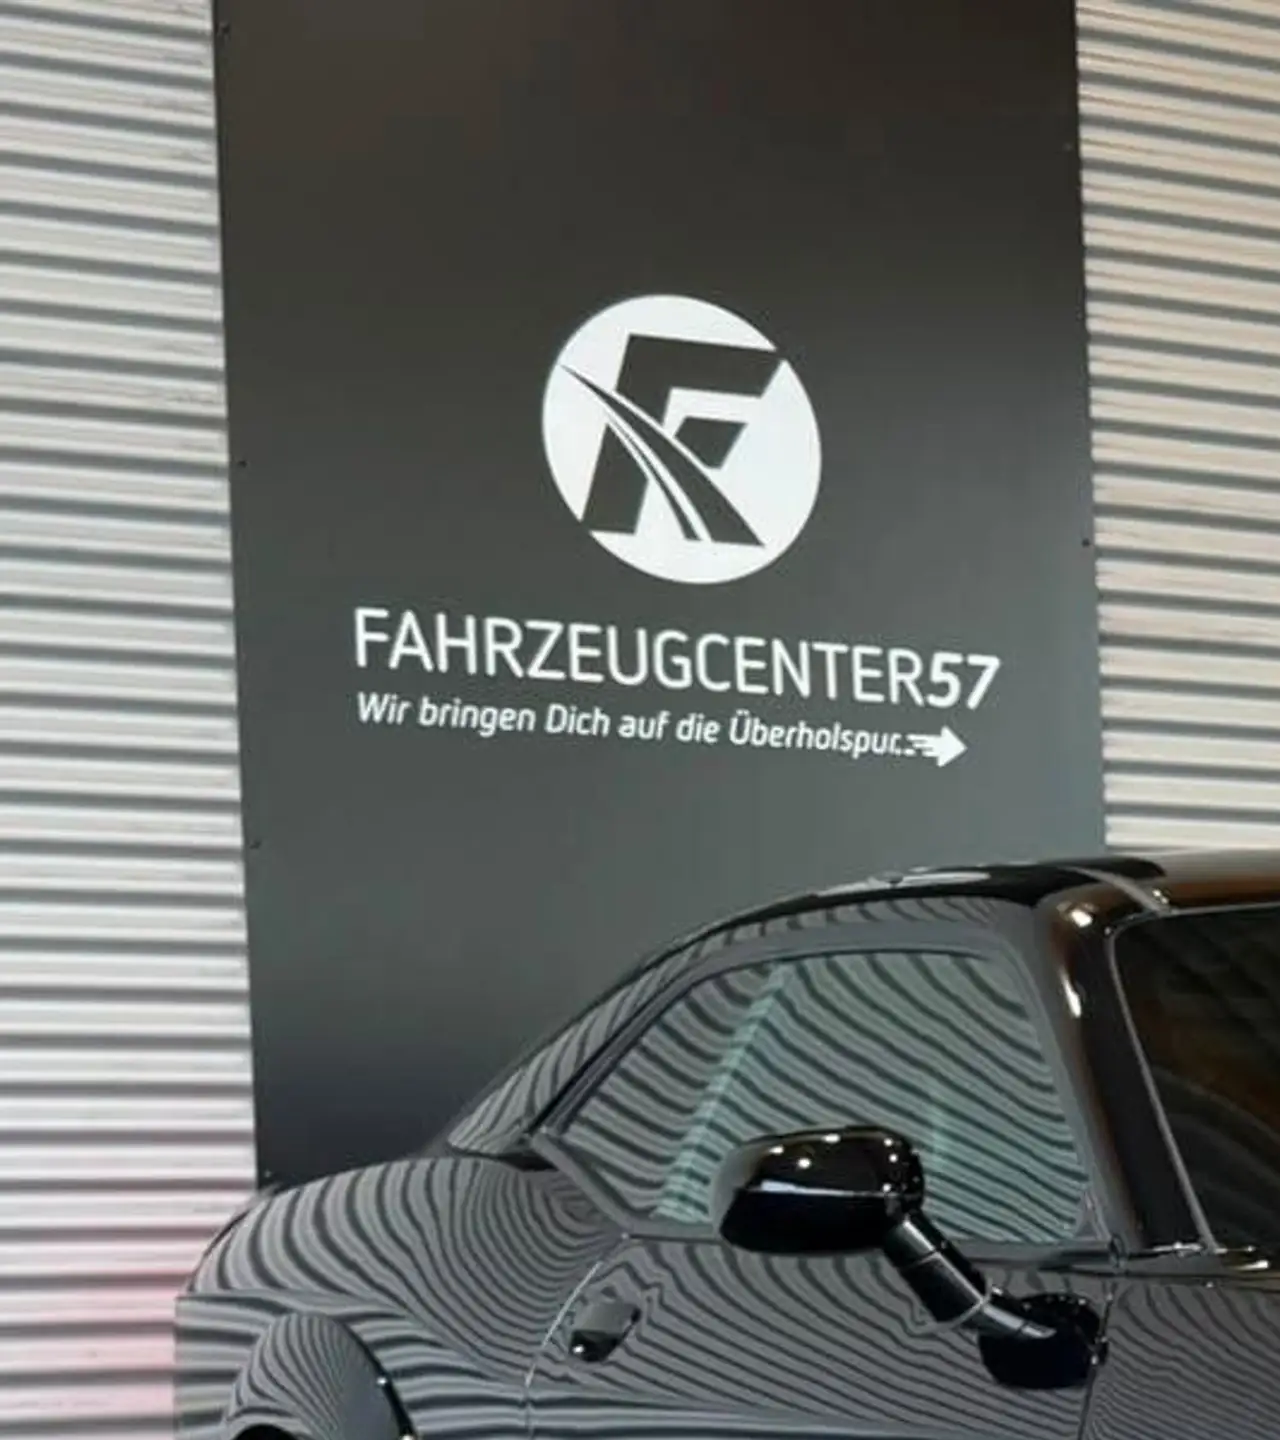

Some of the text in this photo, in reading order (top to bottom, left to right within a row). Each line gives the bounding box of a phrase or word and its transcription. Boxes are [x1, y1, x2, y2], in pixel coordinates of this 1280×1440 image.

[354, 606, 1002, 711] FAHRZEUGCENTER57
[357, 691, 411, 725] Wir
[418, 695, 537, 738] bringen
[544, 703, 611, 738] Dich
[617, 710, 672, 741] auf
[675, 712, 722, 744] die
